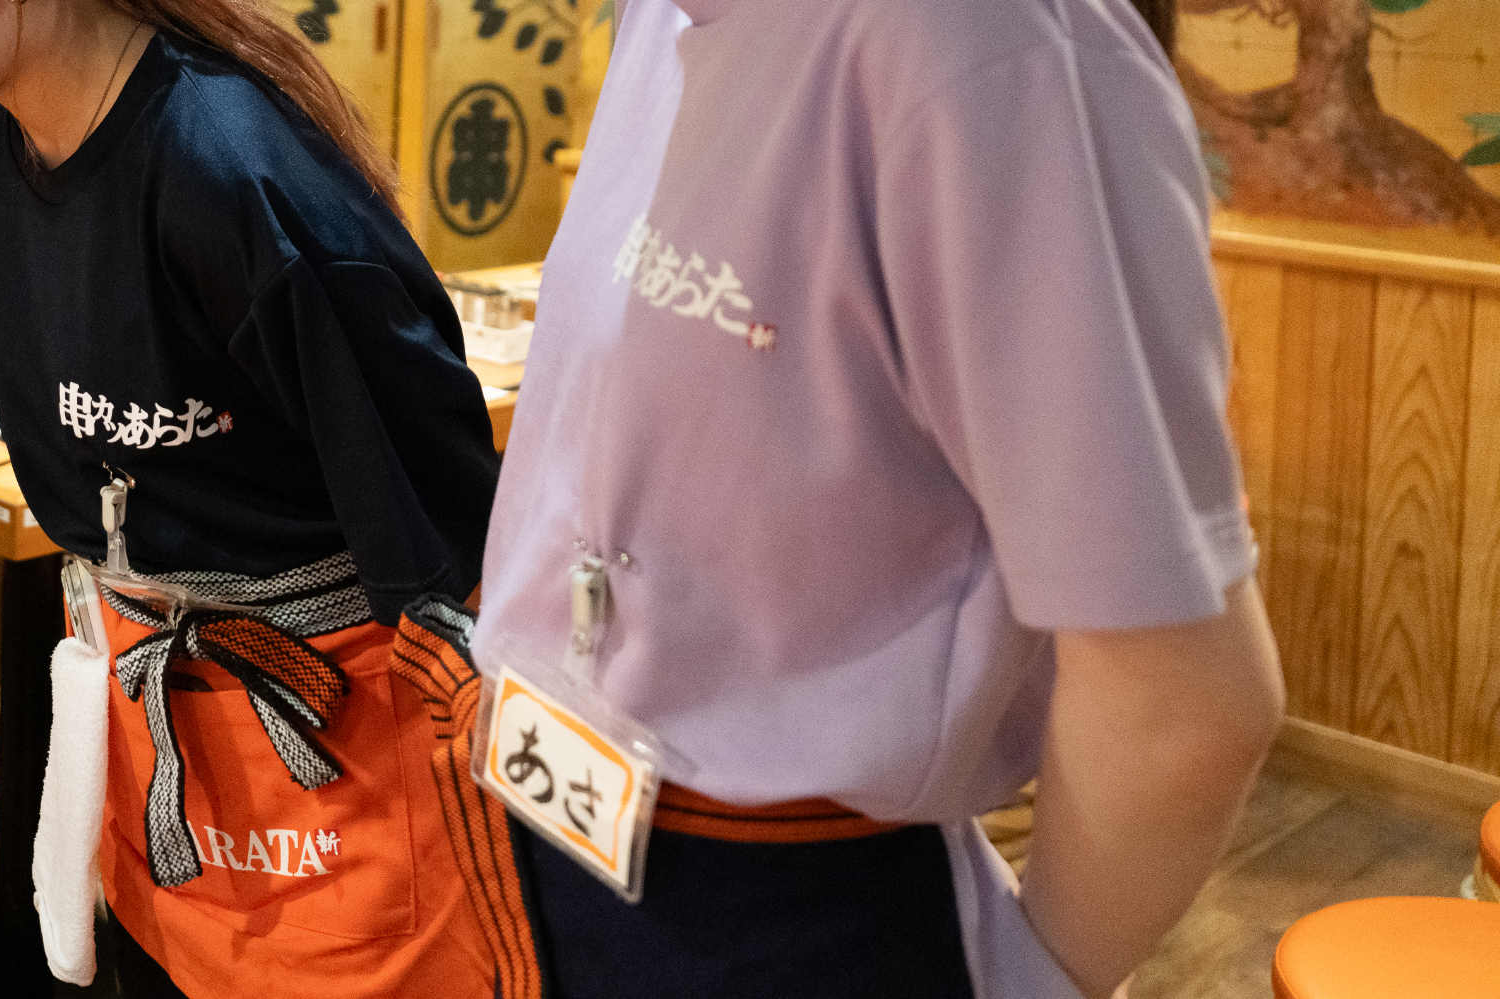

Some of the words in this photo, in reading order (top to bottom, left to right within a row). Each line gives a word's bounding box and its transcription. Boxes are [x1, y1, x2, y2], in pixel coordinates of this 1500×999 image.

[58, 381, 219, 450] 串カツあらた
[504, 721, 603, 838] あさ
[316, 828, 342, 856] 新
